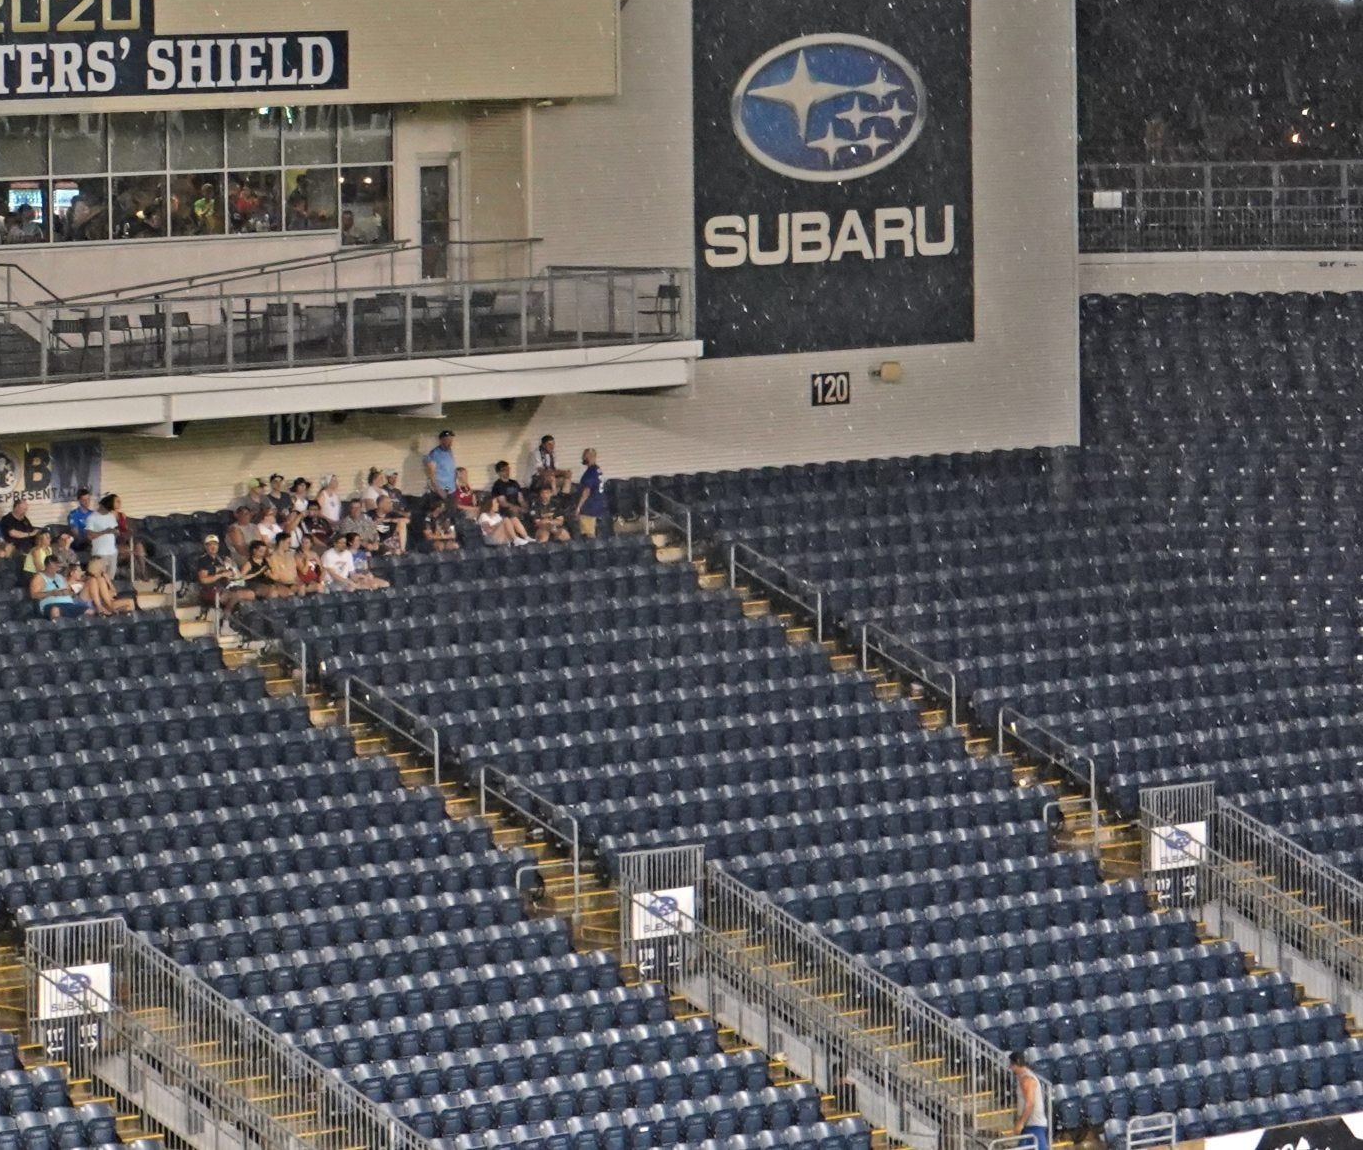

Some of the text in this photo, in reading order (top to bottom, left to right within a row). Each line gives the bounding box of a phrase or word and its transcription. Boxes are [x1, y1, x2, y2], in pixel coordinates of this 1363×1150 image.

[147, 36, 335, 90] SHIELD
[703, 203, 955, 269] SUBARU
[814, 374, 849, 405] 120
[272, 413, 312, 443] 119
